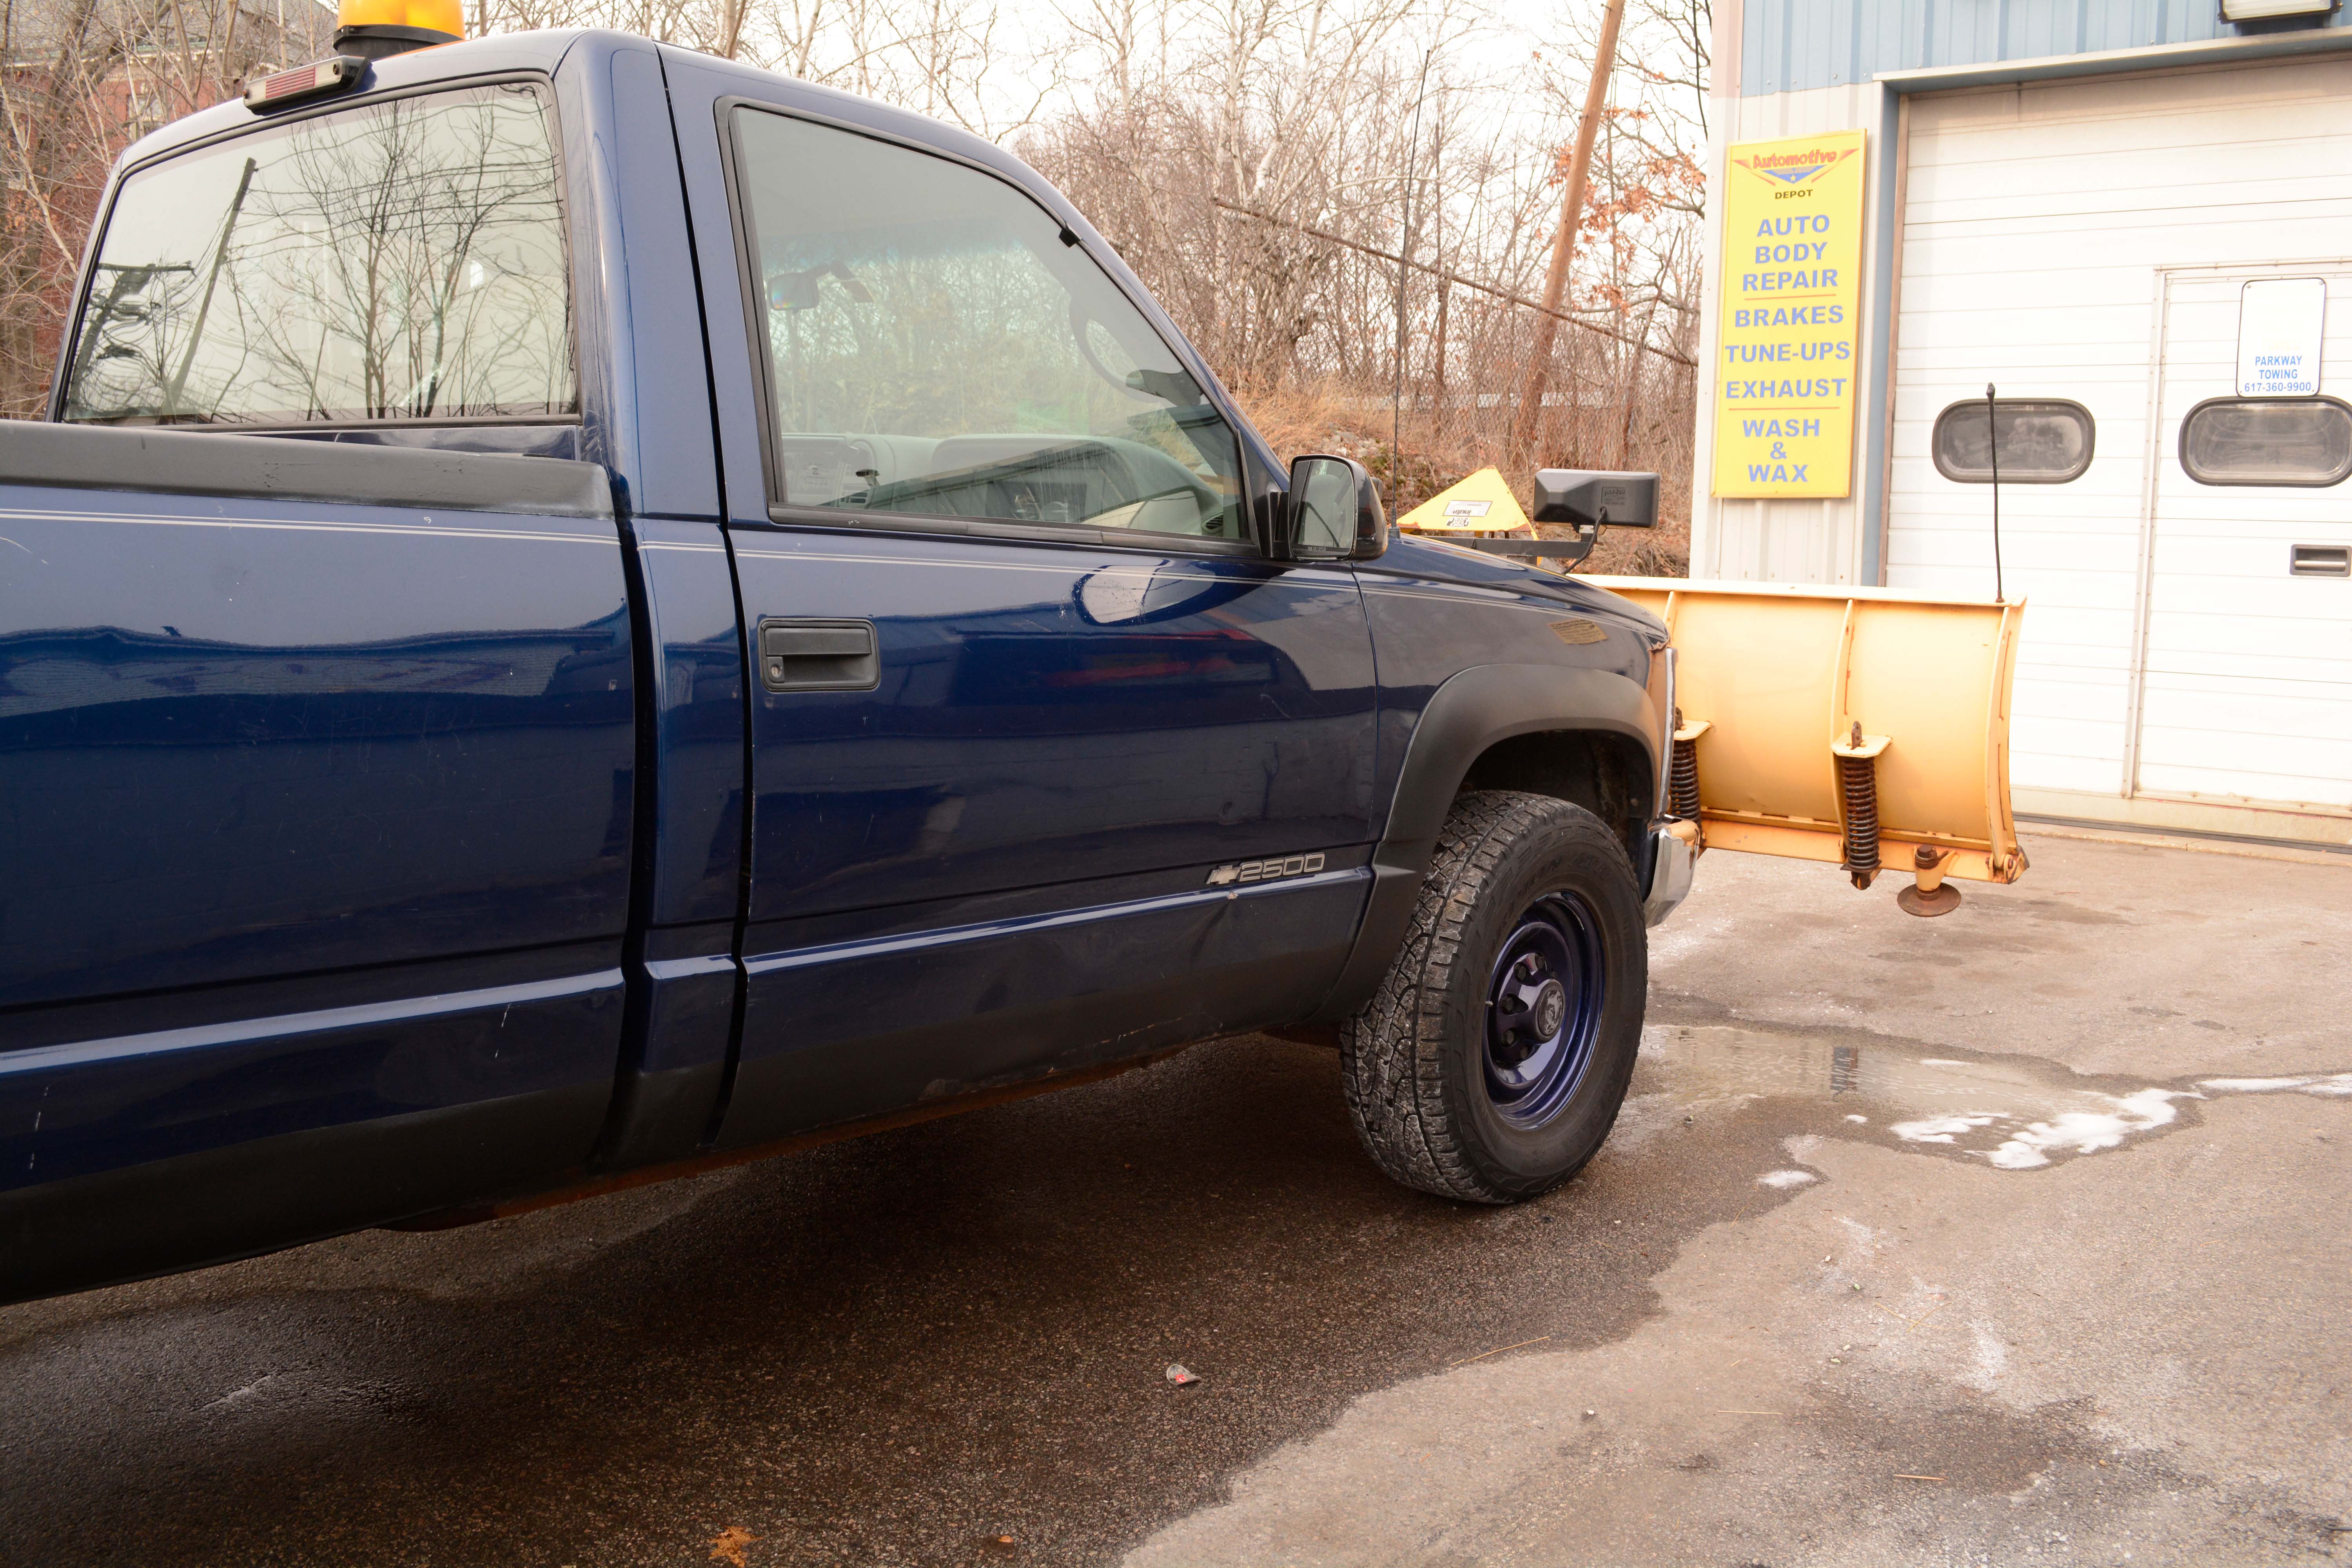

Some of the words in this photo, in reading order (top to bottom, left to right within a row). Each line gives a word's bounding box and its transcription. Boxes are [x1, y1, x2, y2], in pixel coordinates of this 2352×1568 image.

[1753, 149, 1837, 169] Automotive
[1775, 189, 1813, 200] DEPOT
[1757, 214, 1830, 237] AUTO
[1755, 241, 1828, 264] BODY
[1742, 269, 1838, 292] REPAIR
[1735, 305, 1844, 327] BRAKES
[1725, 341, 1851, 363] TUNE-UPS
[2255, 355, 2302, 366] PARKWAY
[2259, 369, 2298, 379] TOWING
[1726, 378, 1847, 399] EXHAUST
[2245, 382, 2311, 392] 617-360-9900
[1742, 419, 1820, 437] WASH
[1769, 441, 1788, 460] &
[1748, 464, 1809, 483] WAX
[1239, 852, 1325, 882] 2500
